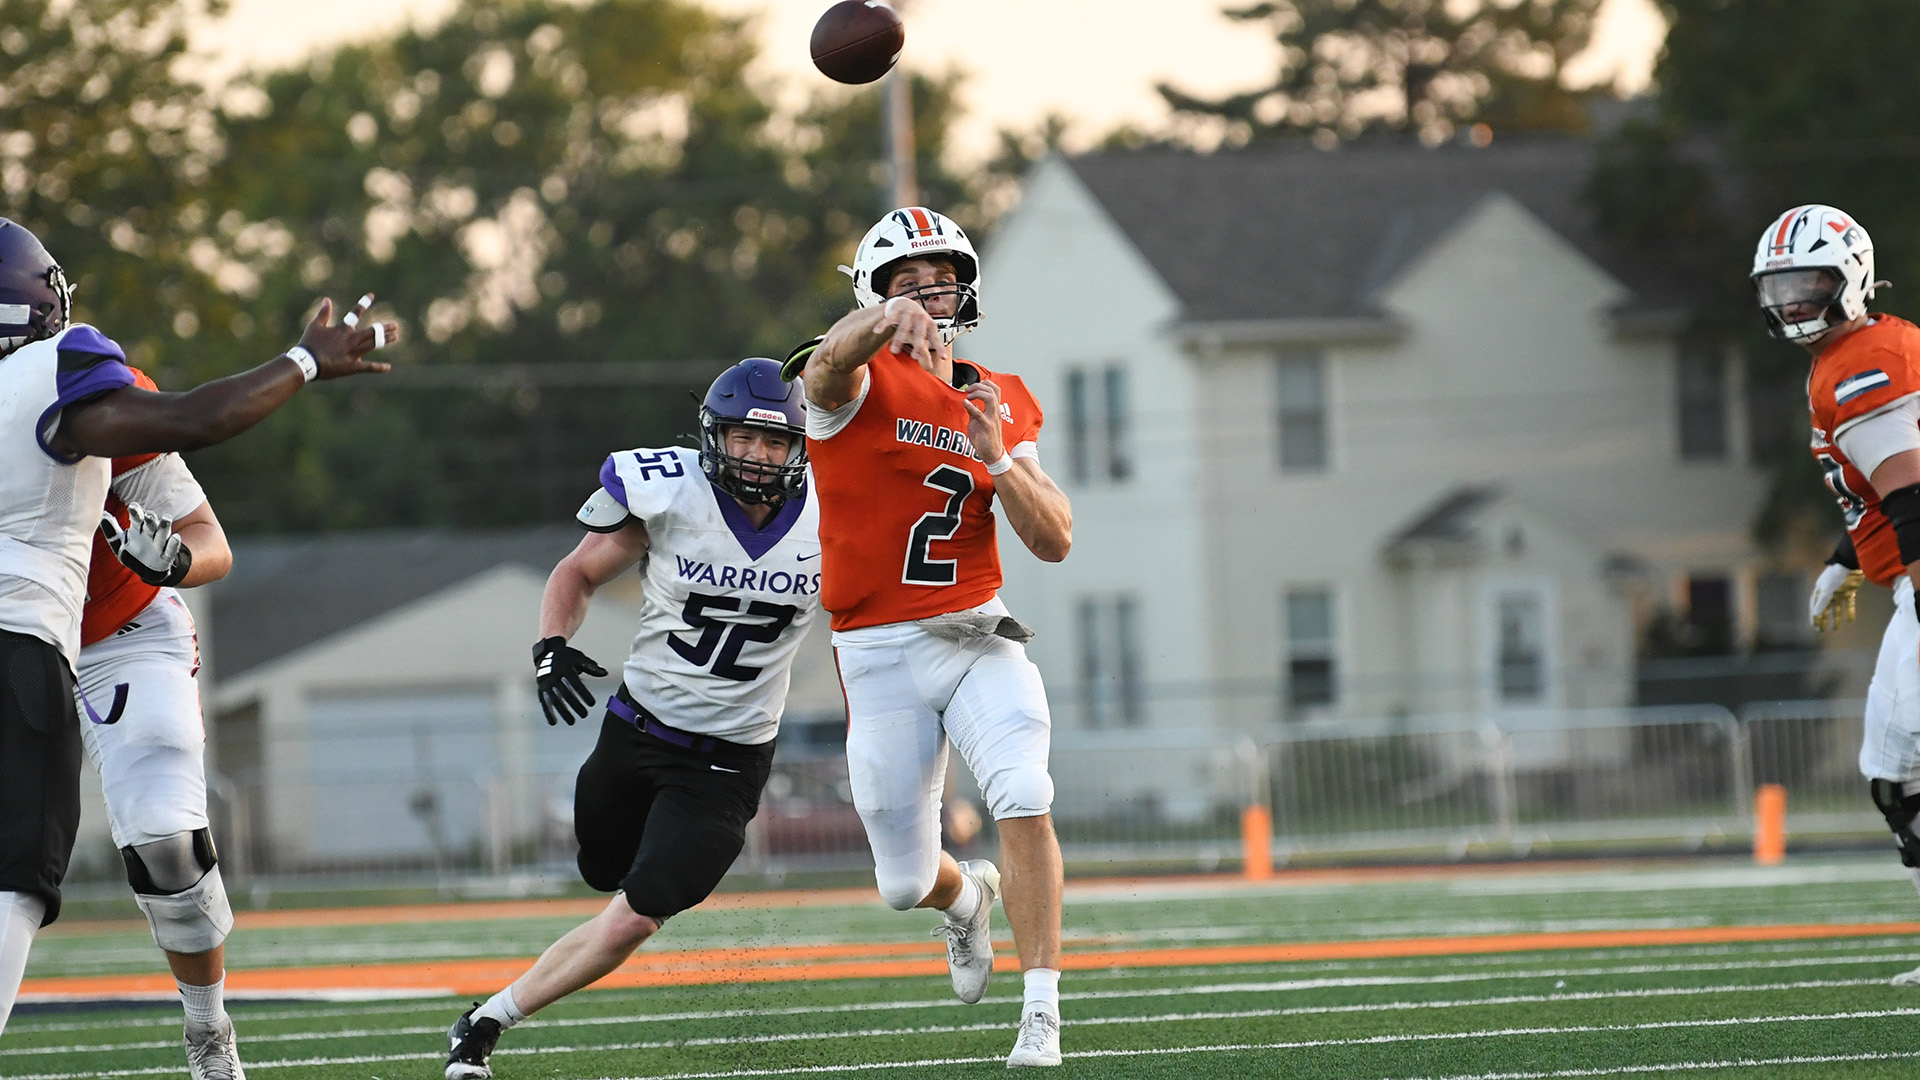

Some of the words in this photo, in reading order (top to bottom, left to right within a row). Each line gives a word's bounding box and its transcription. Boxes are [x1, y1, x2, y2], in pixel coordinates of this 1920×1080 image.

[911, 238, 947, 249] Riddell
[633, 451, 684, 481] 52
[901, 463, 975, 586] 2
[675, 555, 821, 595] WARRIORS
[667, 592, 798, 681] 52
